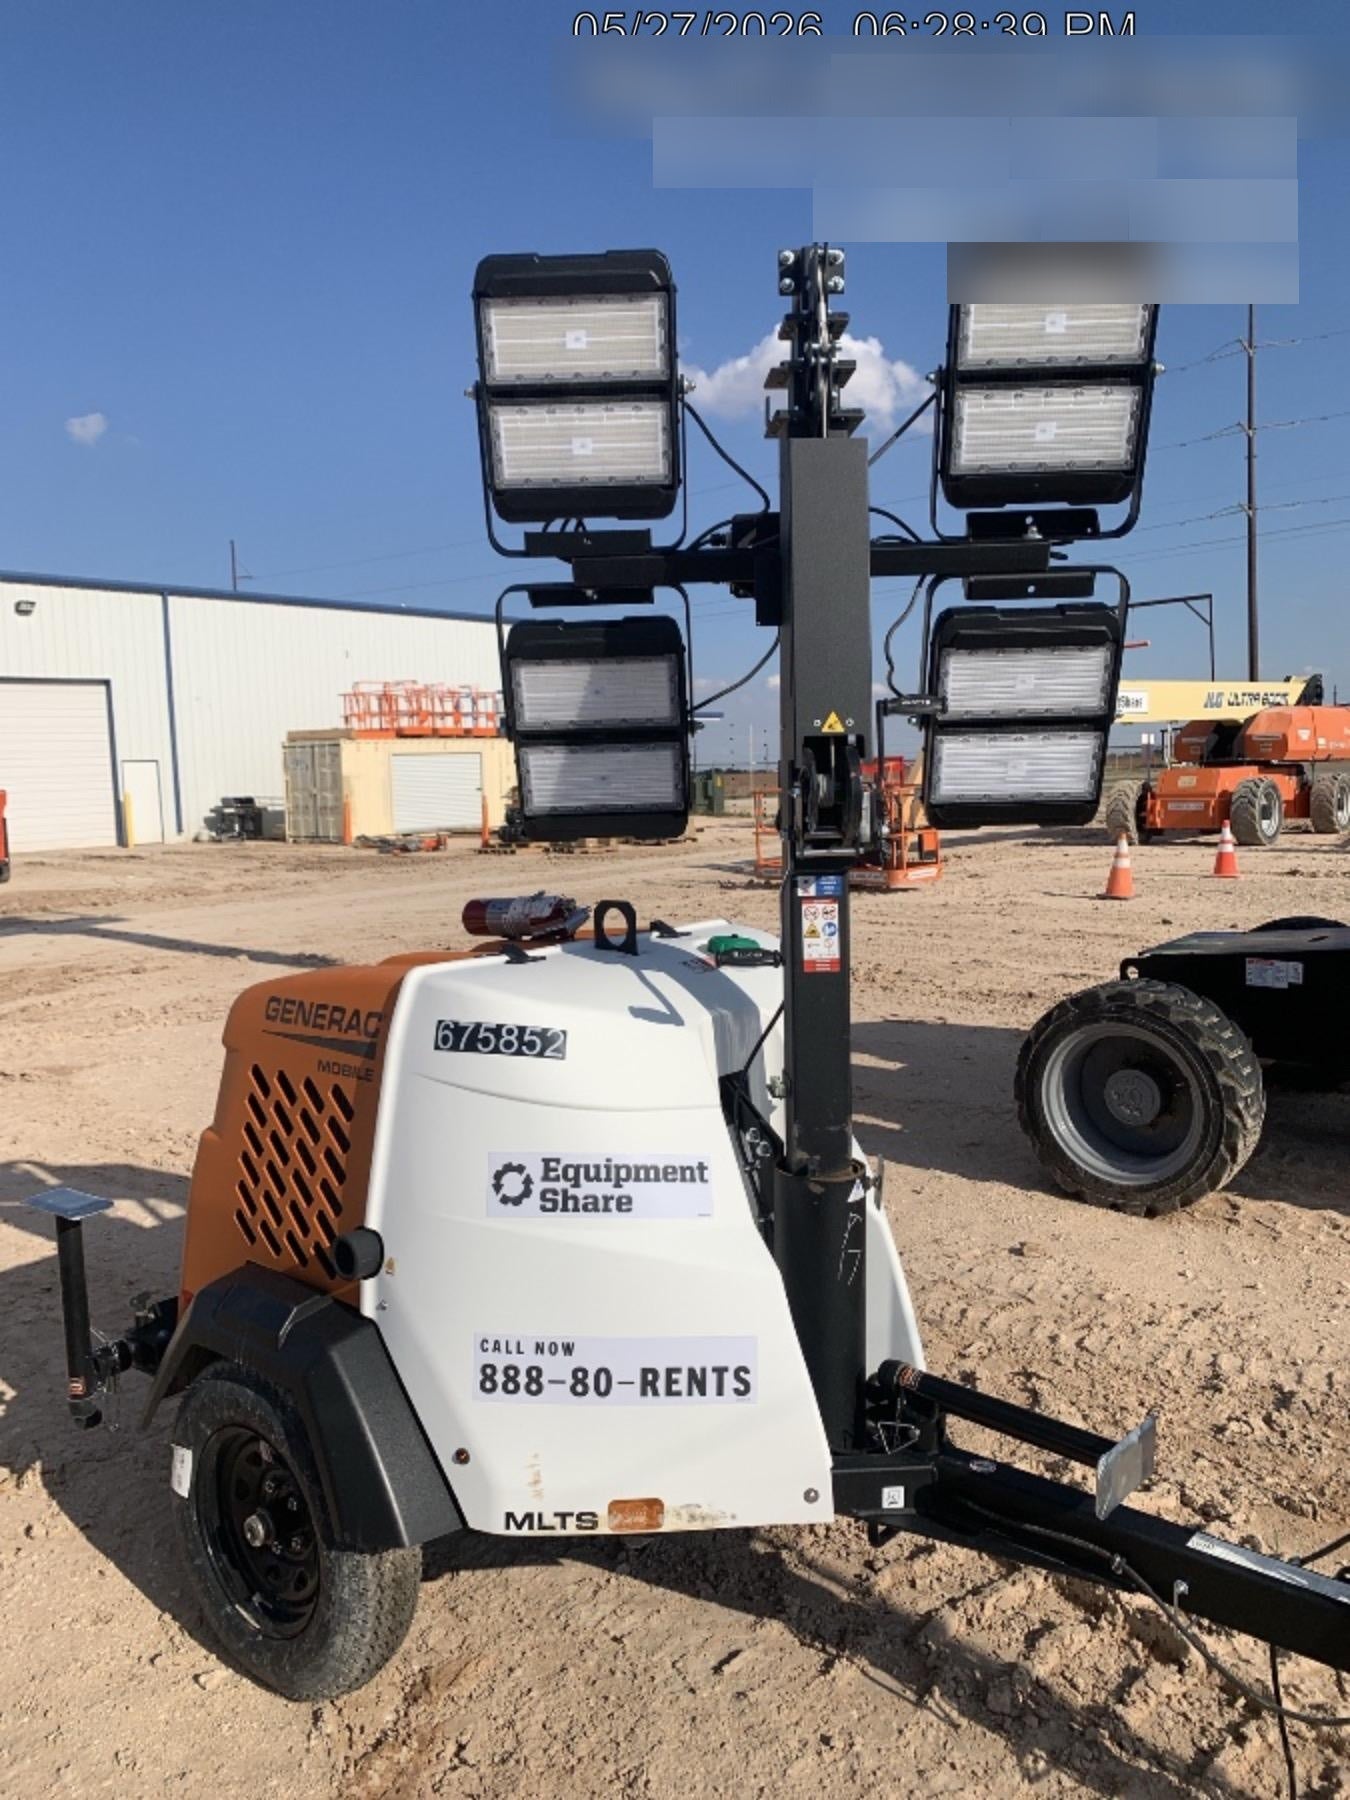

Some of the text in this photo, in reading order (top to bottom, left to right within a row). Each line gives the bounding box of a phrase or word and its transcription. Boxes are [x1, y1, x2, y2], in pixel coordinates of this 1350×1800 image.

[265, 996, 383, 1038] GENERAC
[436, 1020, 566, 1058] 675852
[317, 1060, 374, 1082] MOBILE
[540, 1157, 709, 1188] Equipment
[539, 1188, 633, 1213] Share
[480, 1339, 575, 1356] CALL NOW
[479, 1363, 751, 1398] 888-80-RENTS
[504, 1511, 599, 1531] MLTS
